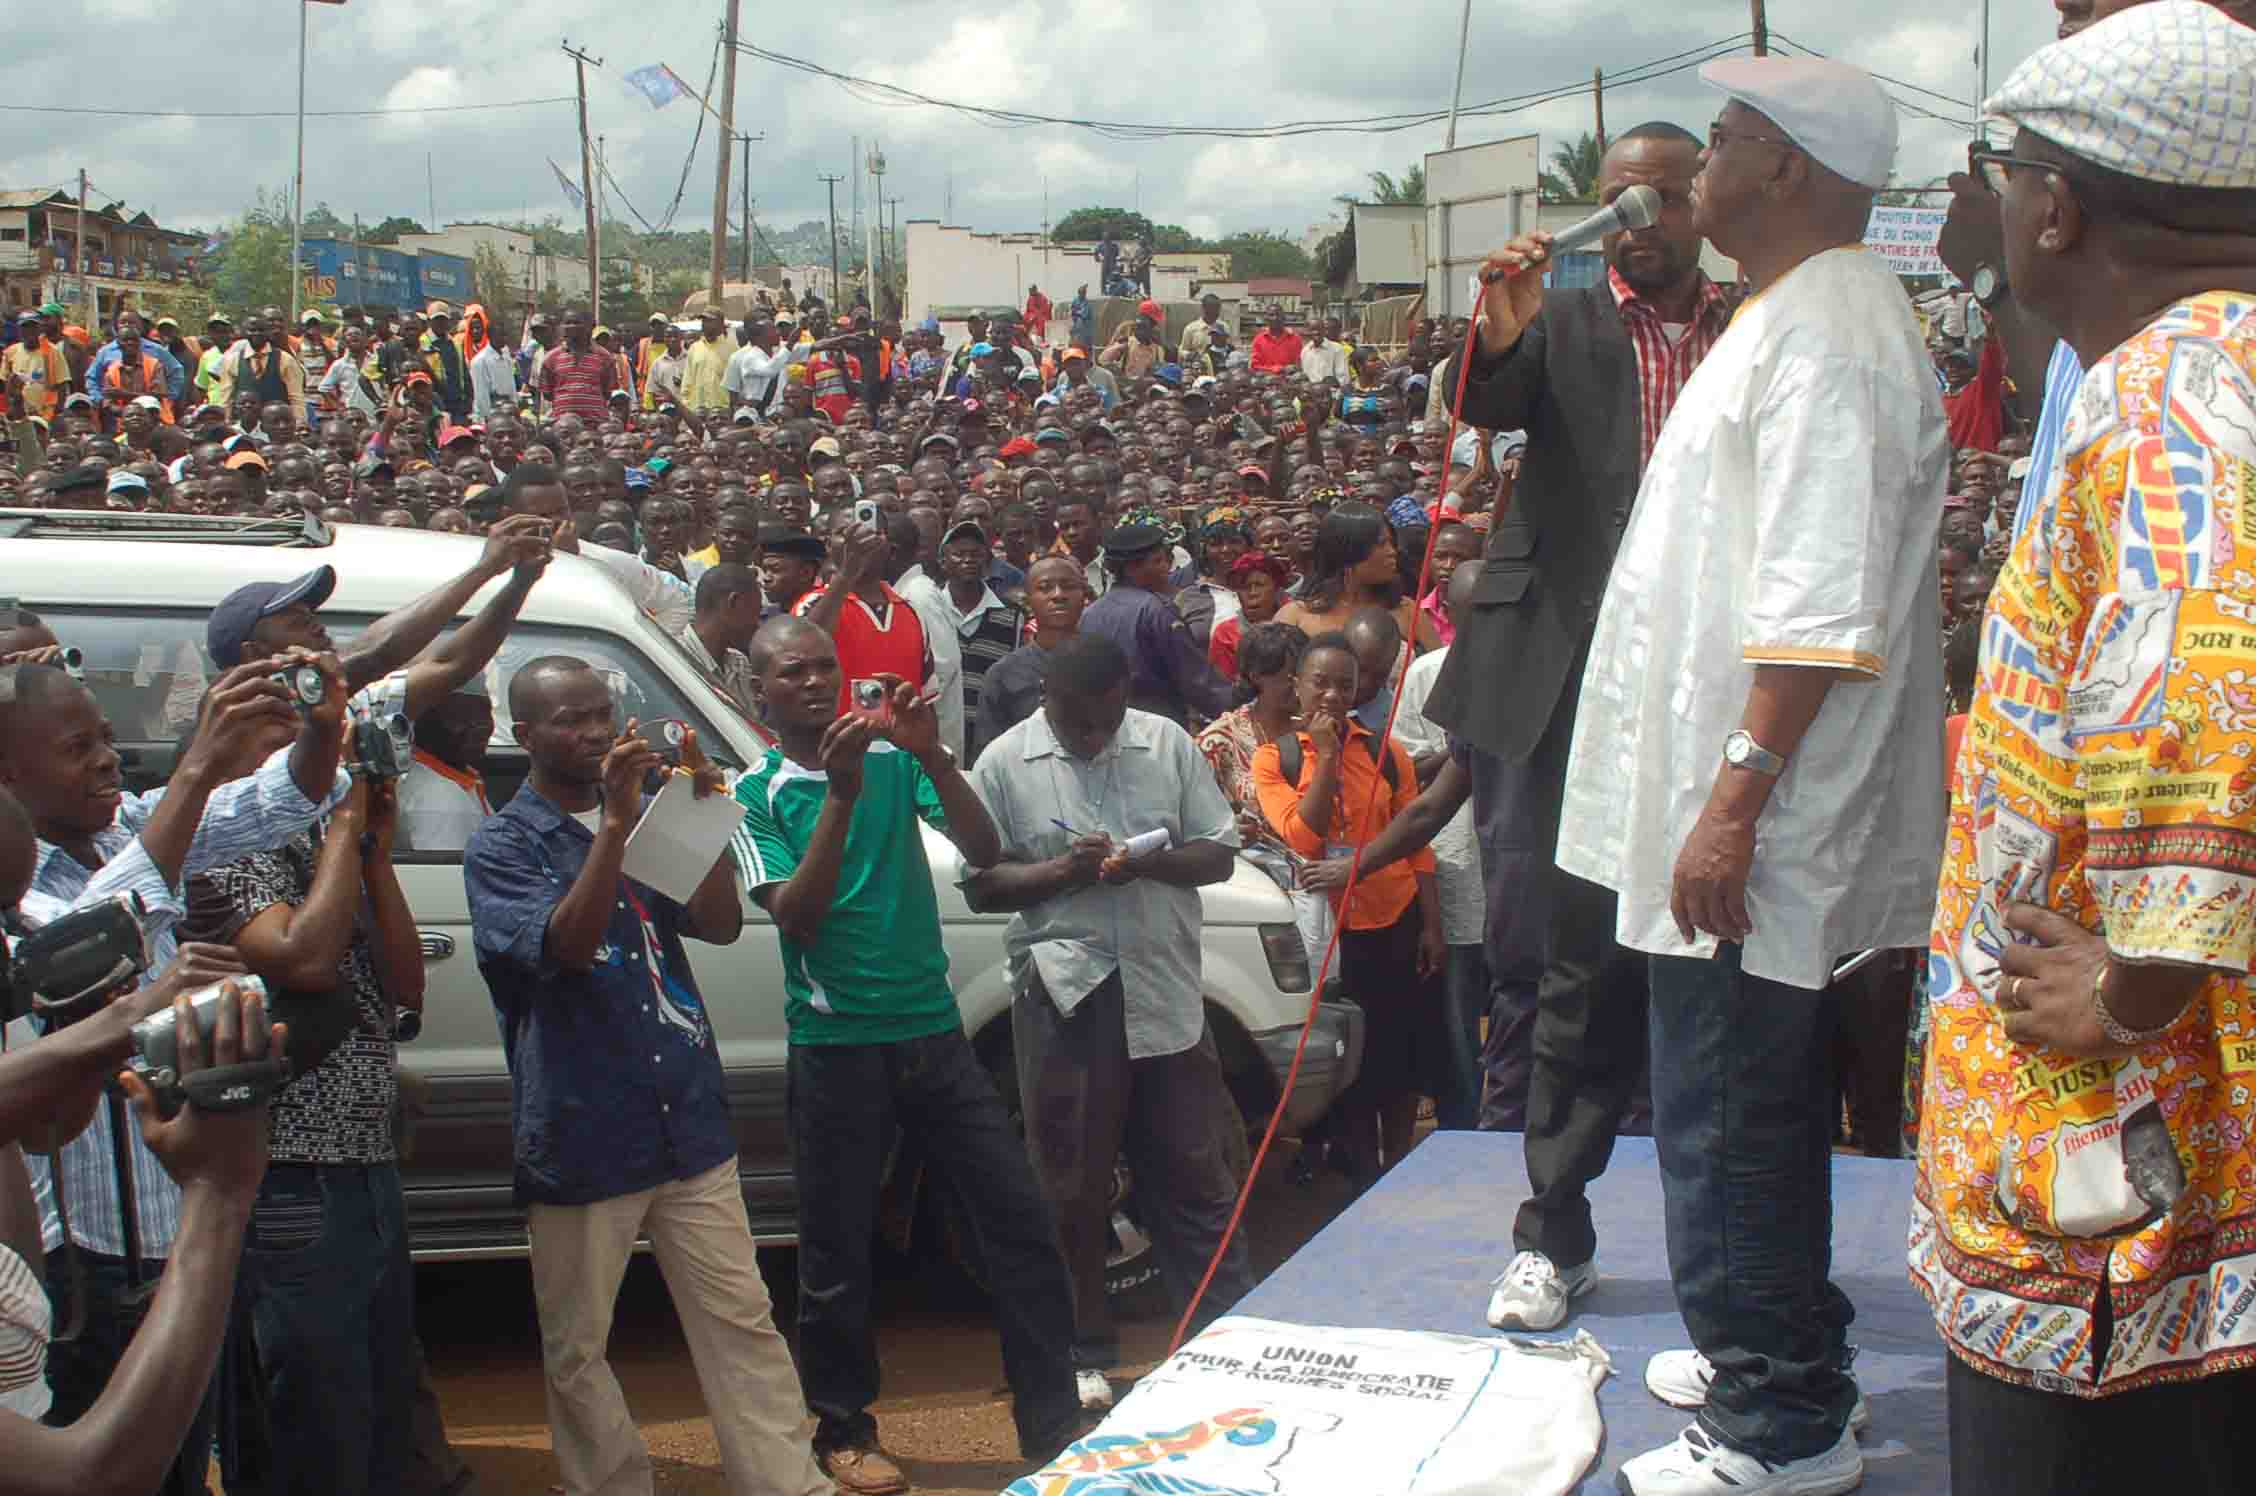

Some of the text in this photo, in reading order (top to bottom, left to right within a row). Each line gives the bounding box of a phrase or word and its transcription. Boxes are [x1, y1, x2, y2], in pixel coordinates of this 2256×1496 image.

[2183, 632, 2232, 650] RDC
[221, 1086, 250, 1100] JVC
[1262, 1345, 1359, 1370] UNION
[1251, 1361, 1292, 1375] LA
[1298, 1365, 1455, 1392] DEMOCRATIE
